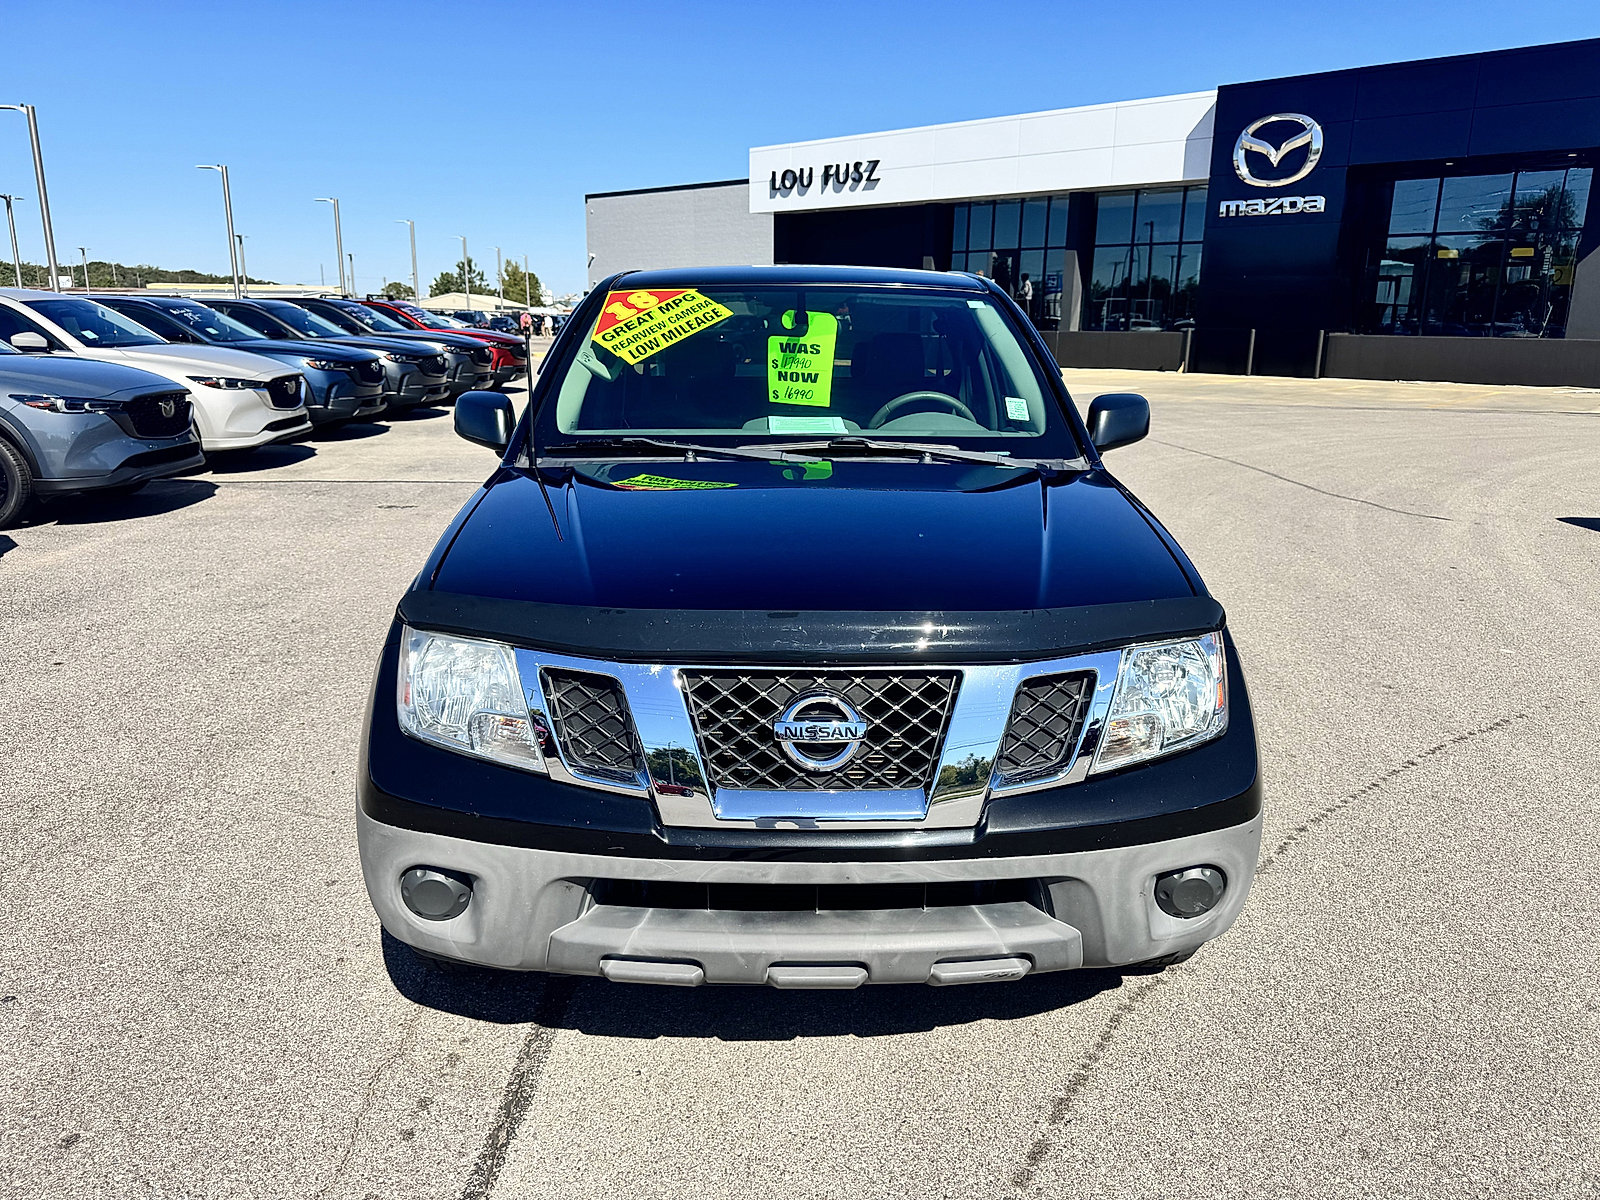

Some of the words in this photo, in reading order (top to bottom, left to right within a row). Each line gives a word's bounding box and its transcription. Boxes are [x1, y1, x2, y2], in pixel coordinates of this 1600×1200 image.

[771, 167, 813, 191] LOU
[823, 159, 881, 186] FUSZ
[601, 311, 655, 342] GREAT
[657, 293, 697, 315] MPG
[604, 291, 660, 321] 18
[611, 320, 667, 353] REARVIEW
[667, 300, 713, 324] CAMERA
[628, 337, 661, 360] LOW
[660, 307, 723, 343] MILEAGE
[779, 342, 821, 354] WAS
[777, 371, 819, 383] NOW
[784, 725, 858, 738] NISSAN
